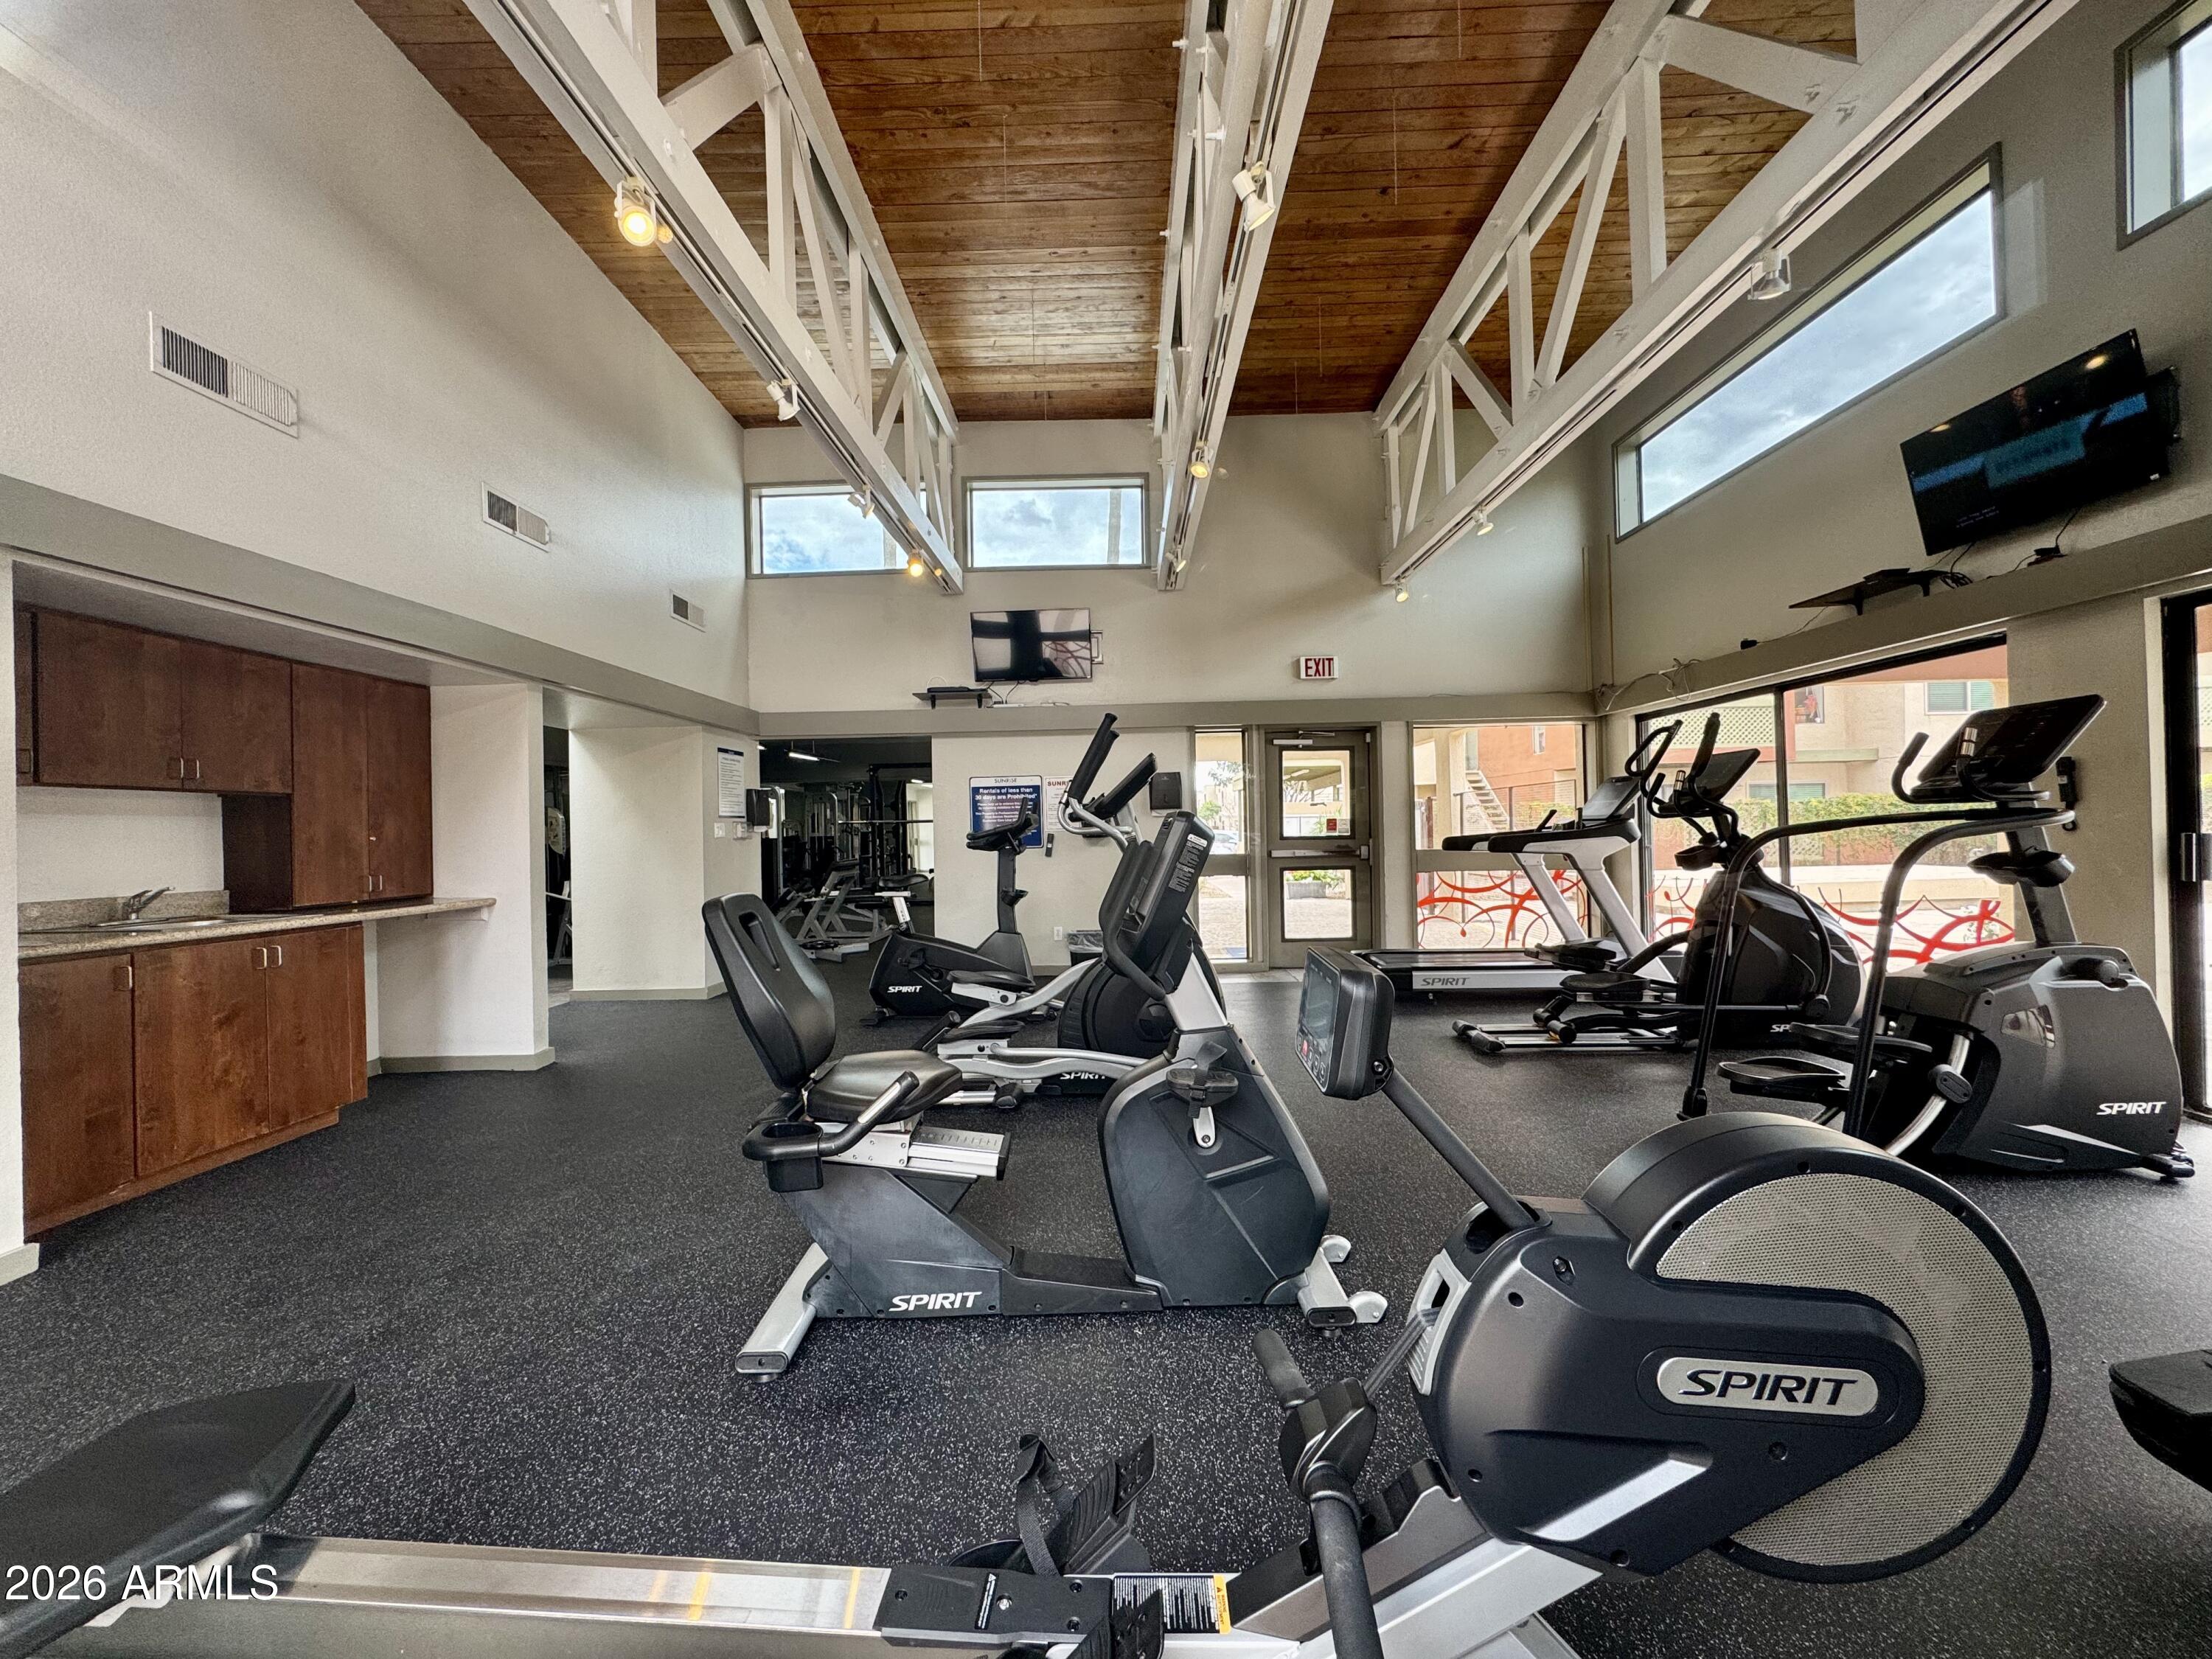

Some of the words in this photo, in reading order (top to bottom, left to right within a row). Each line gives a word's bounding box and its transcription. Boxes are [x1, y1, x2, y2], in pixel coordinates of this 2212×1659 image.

[1305, 658, 1334, 677] EXIT
[887, 985, 922, 993] SPIRIT
[1420, 977, 1470, 987] SPIRIT
[2096, 1101, 2167, 1115] SPIRIT
[888, 1291, 983, 1312] SPIRIT
[1677, 1369, 1858, 1405] SPIRIT
